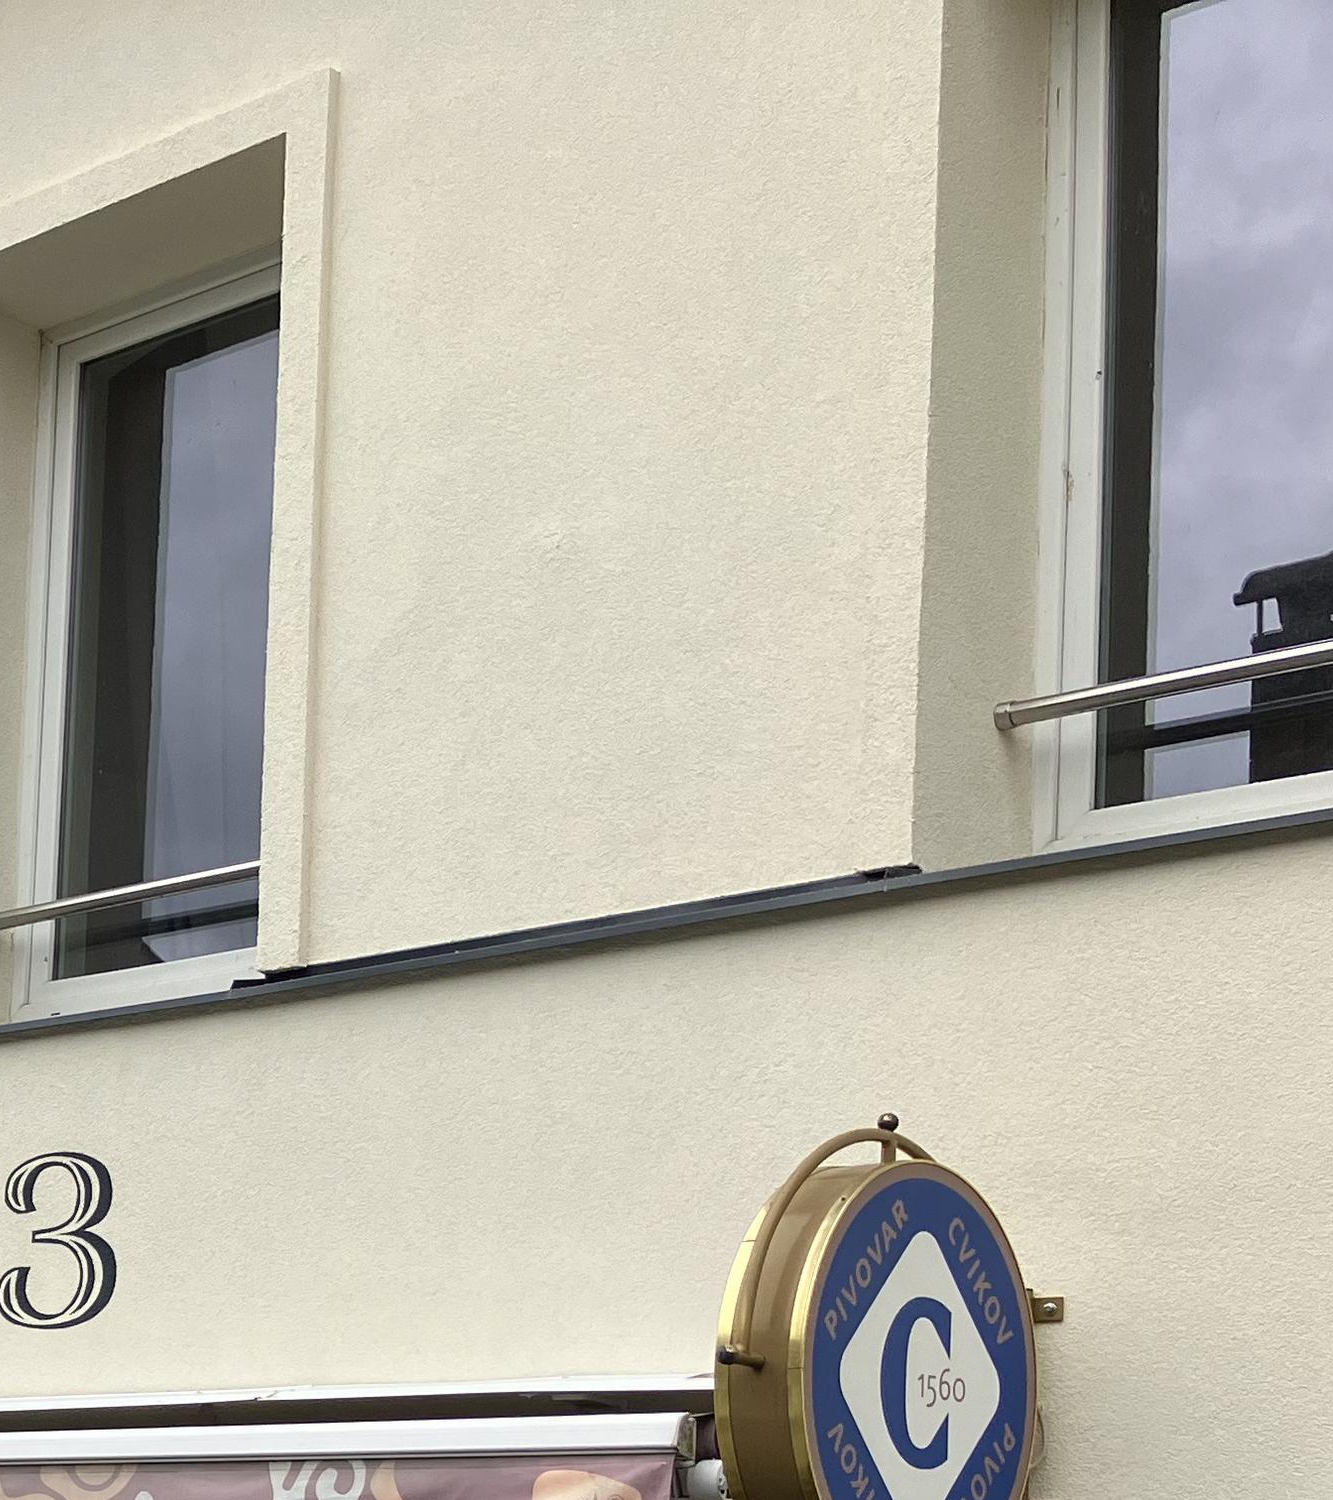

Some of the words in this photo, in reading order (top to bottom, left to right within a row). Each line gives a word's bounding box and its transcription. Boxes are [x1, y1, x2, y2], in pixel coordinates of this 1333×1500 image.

[823, 1198, 909, 1341] PIVOVAR
[947, 1216, 1014, 1346] CVIKOV
[879, 1296, 952, 1470] C
[917, 1368, 966, 1408] 1560
